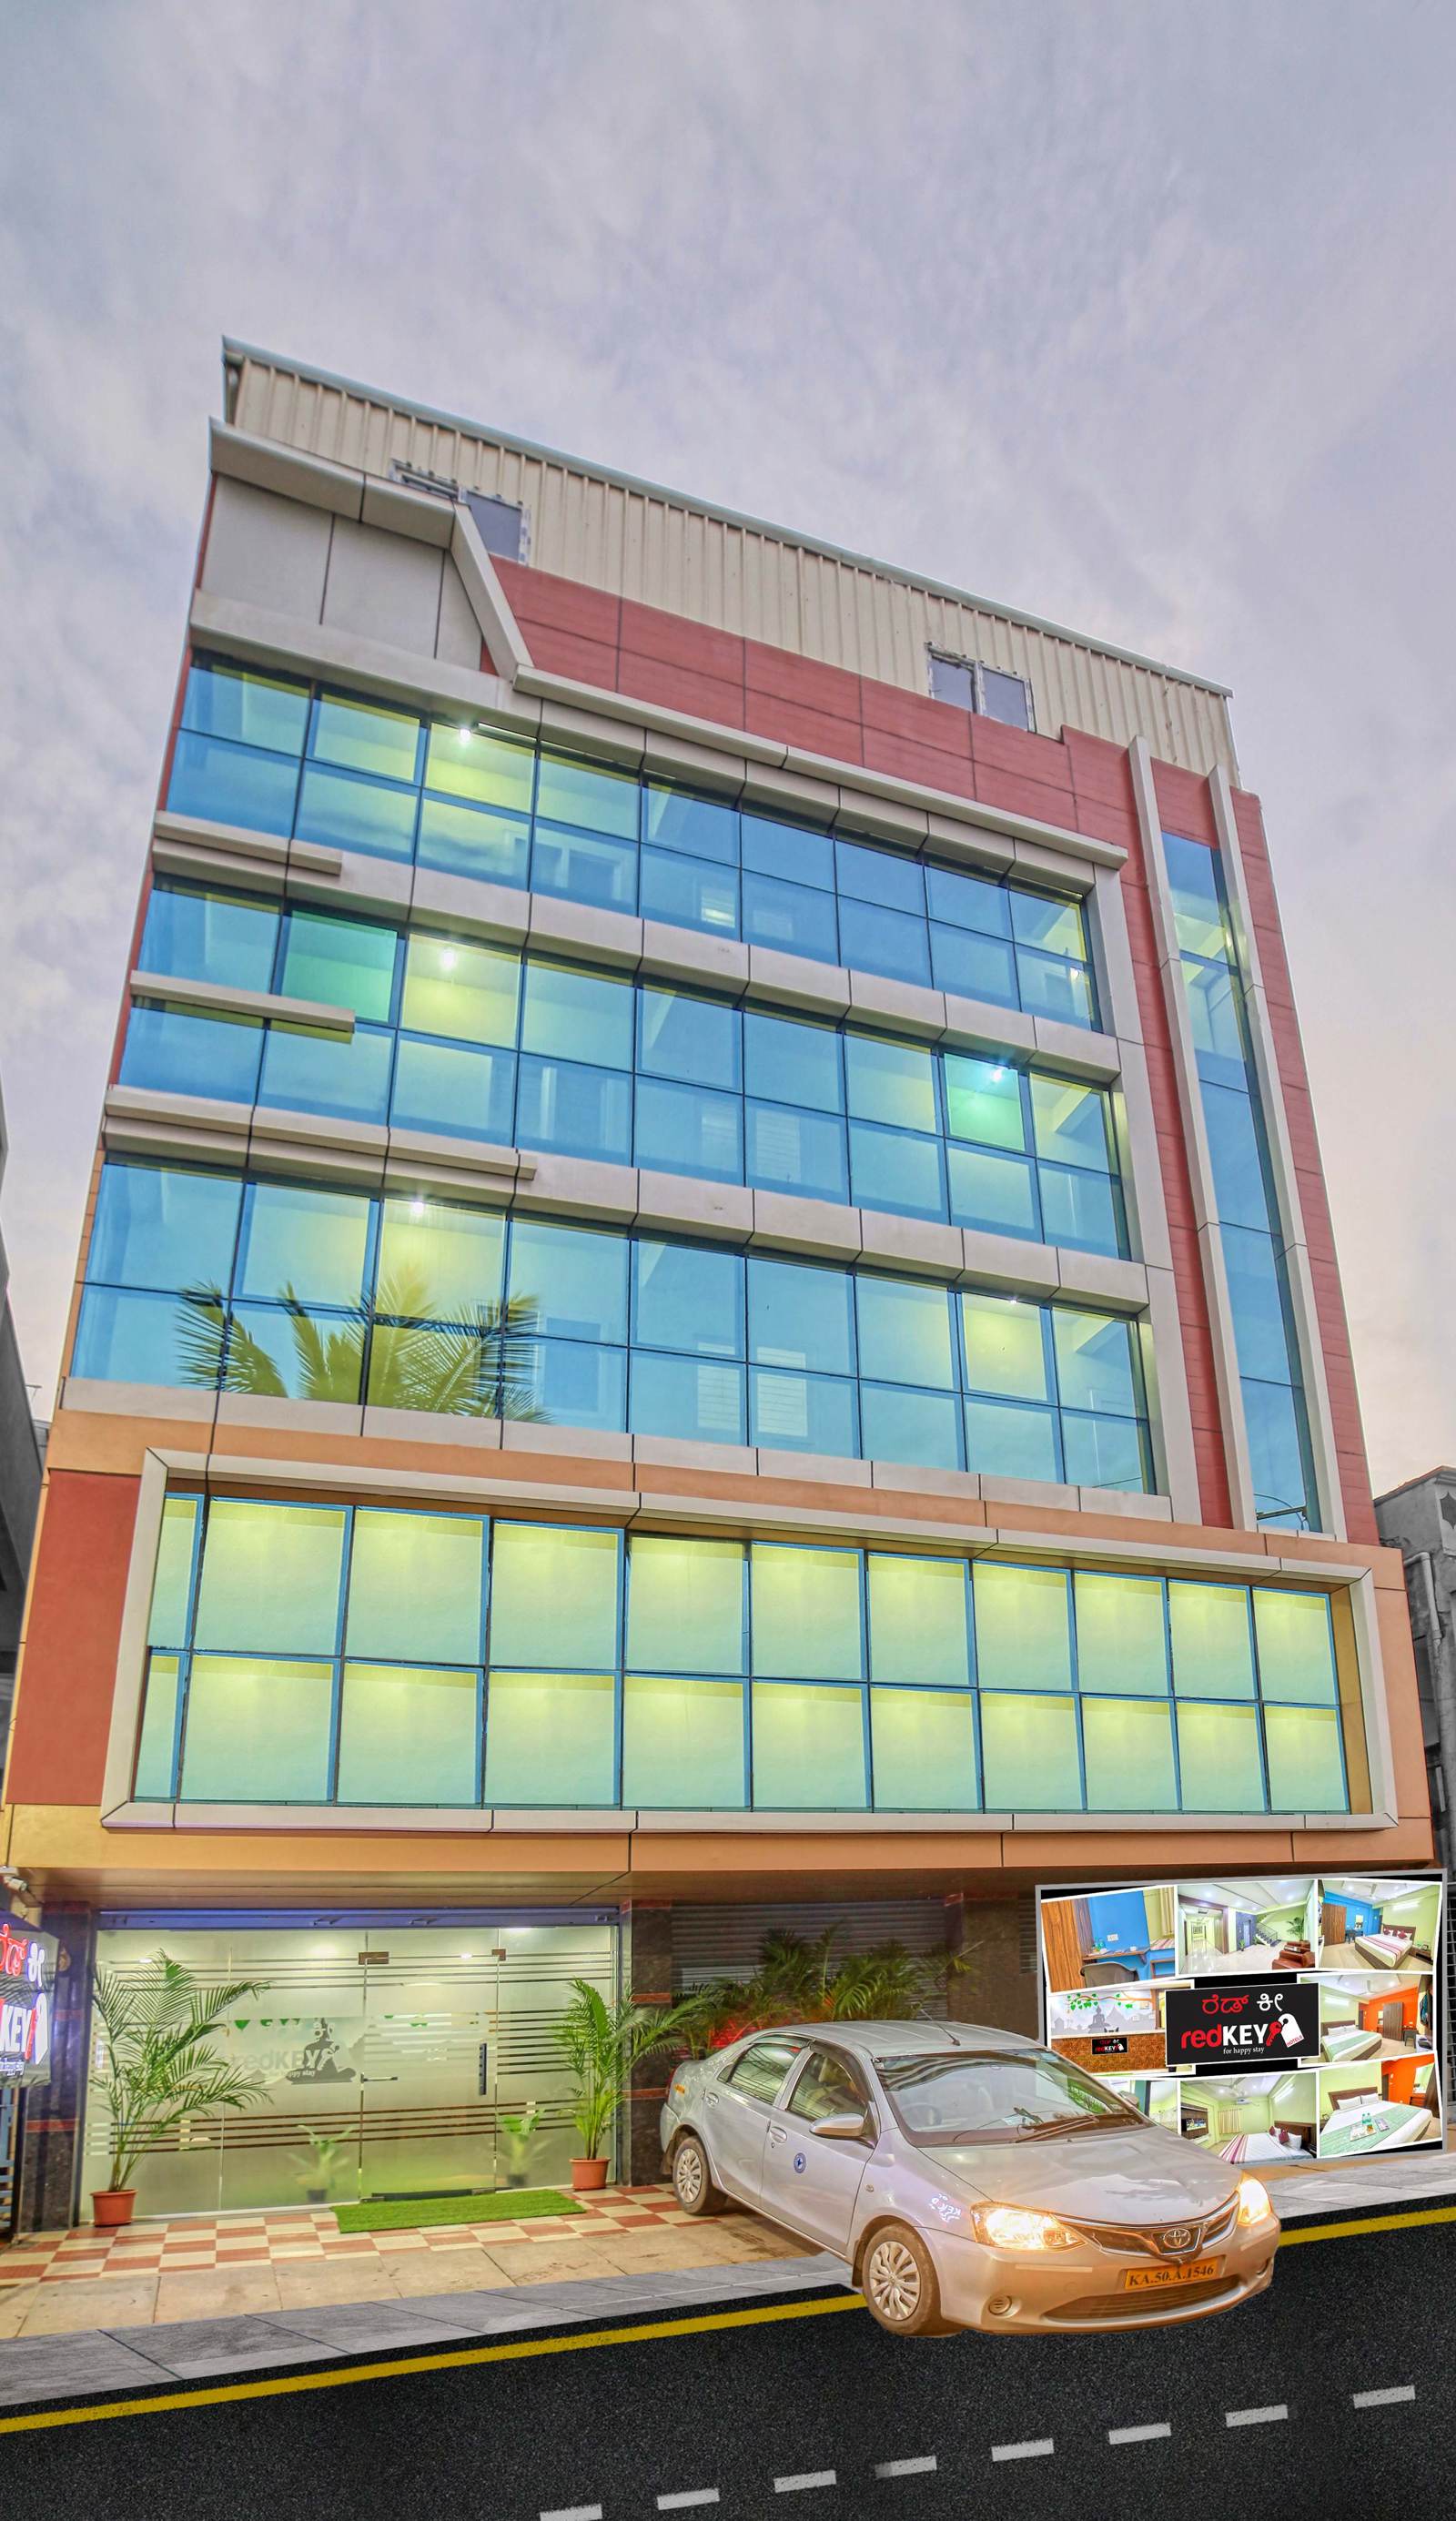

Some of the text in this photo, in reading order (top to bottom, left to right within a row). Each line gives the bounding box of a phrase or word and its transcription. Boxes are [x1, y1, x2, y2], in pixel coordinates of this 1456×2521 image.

[1201, 1993, 1284, 2015] ರೆಡ್ ಕೀ
[1181, 2023, 1269, 2050] redKEY
[1286, 2034, 1303, 2047] HOTELS
[1223, 2046, 1265, 2055] for happy stay
